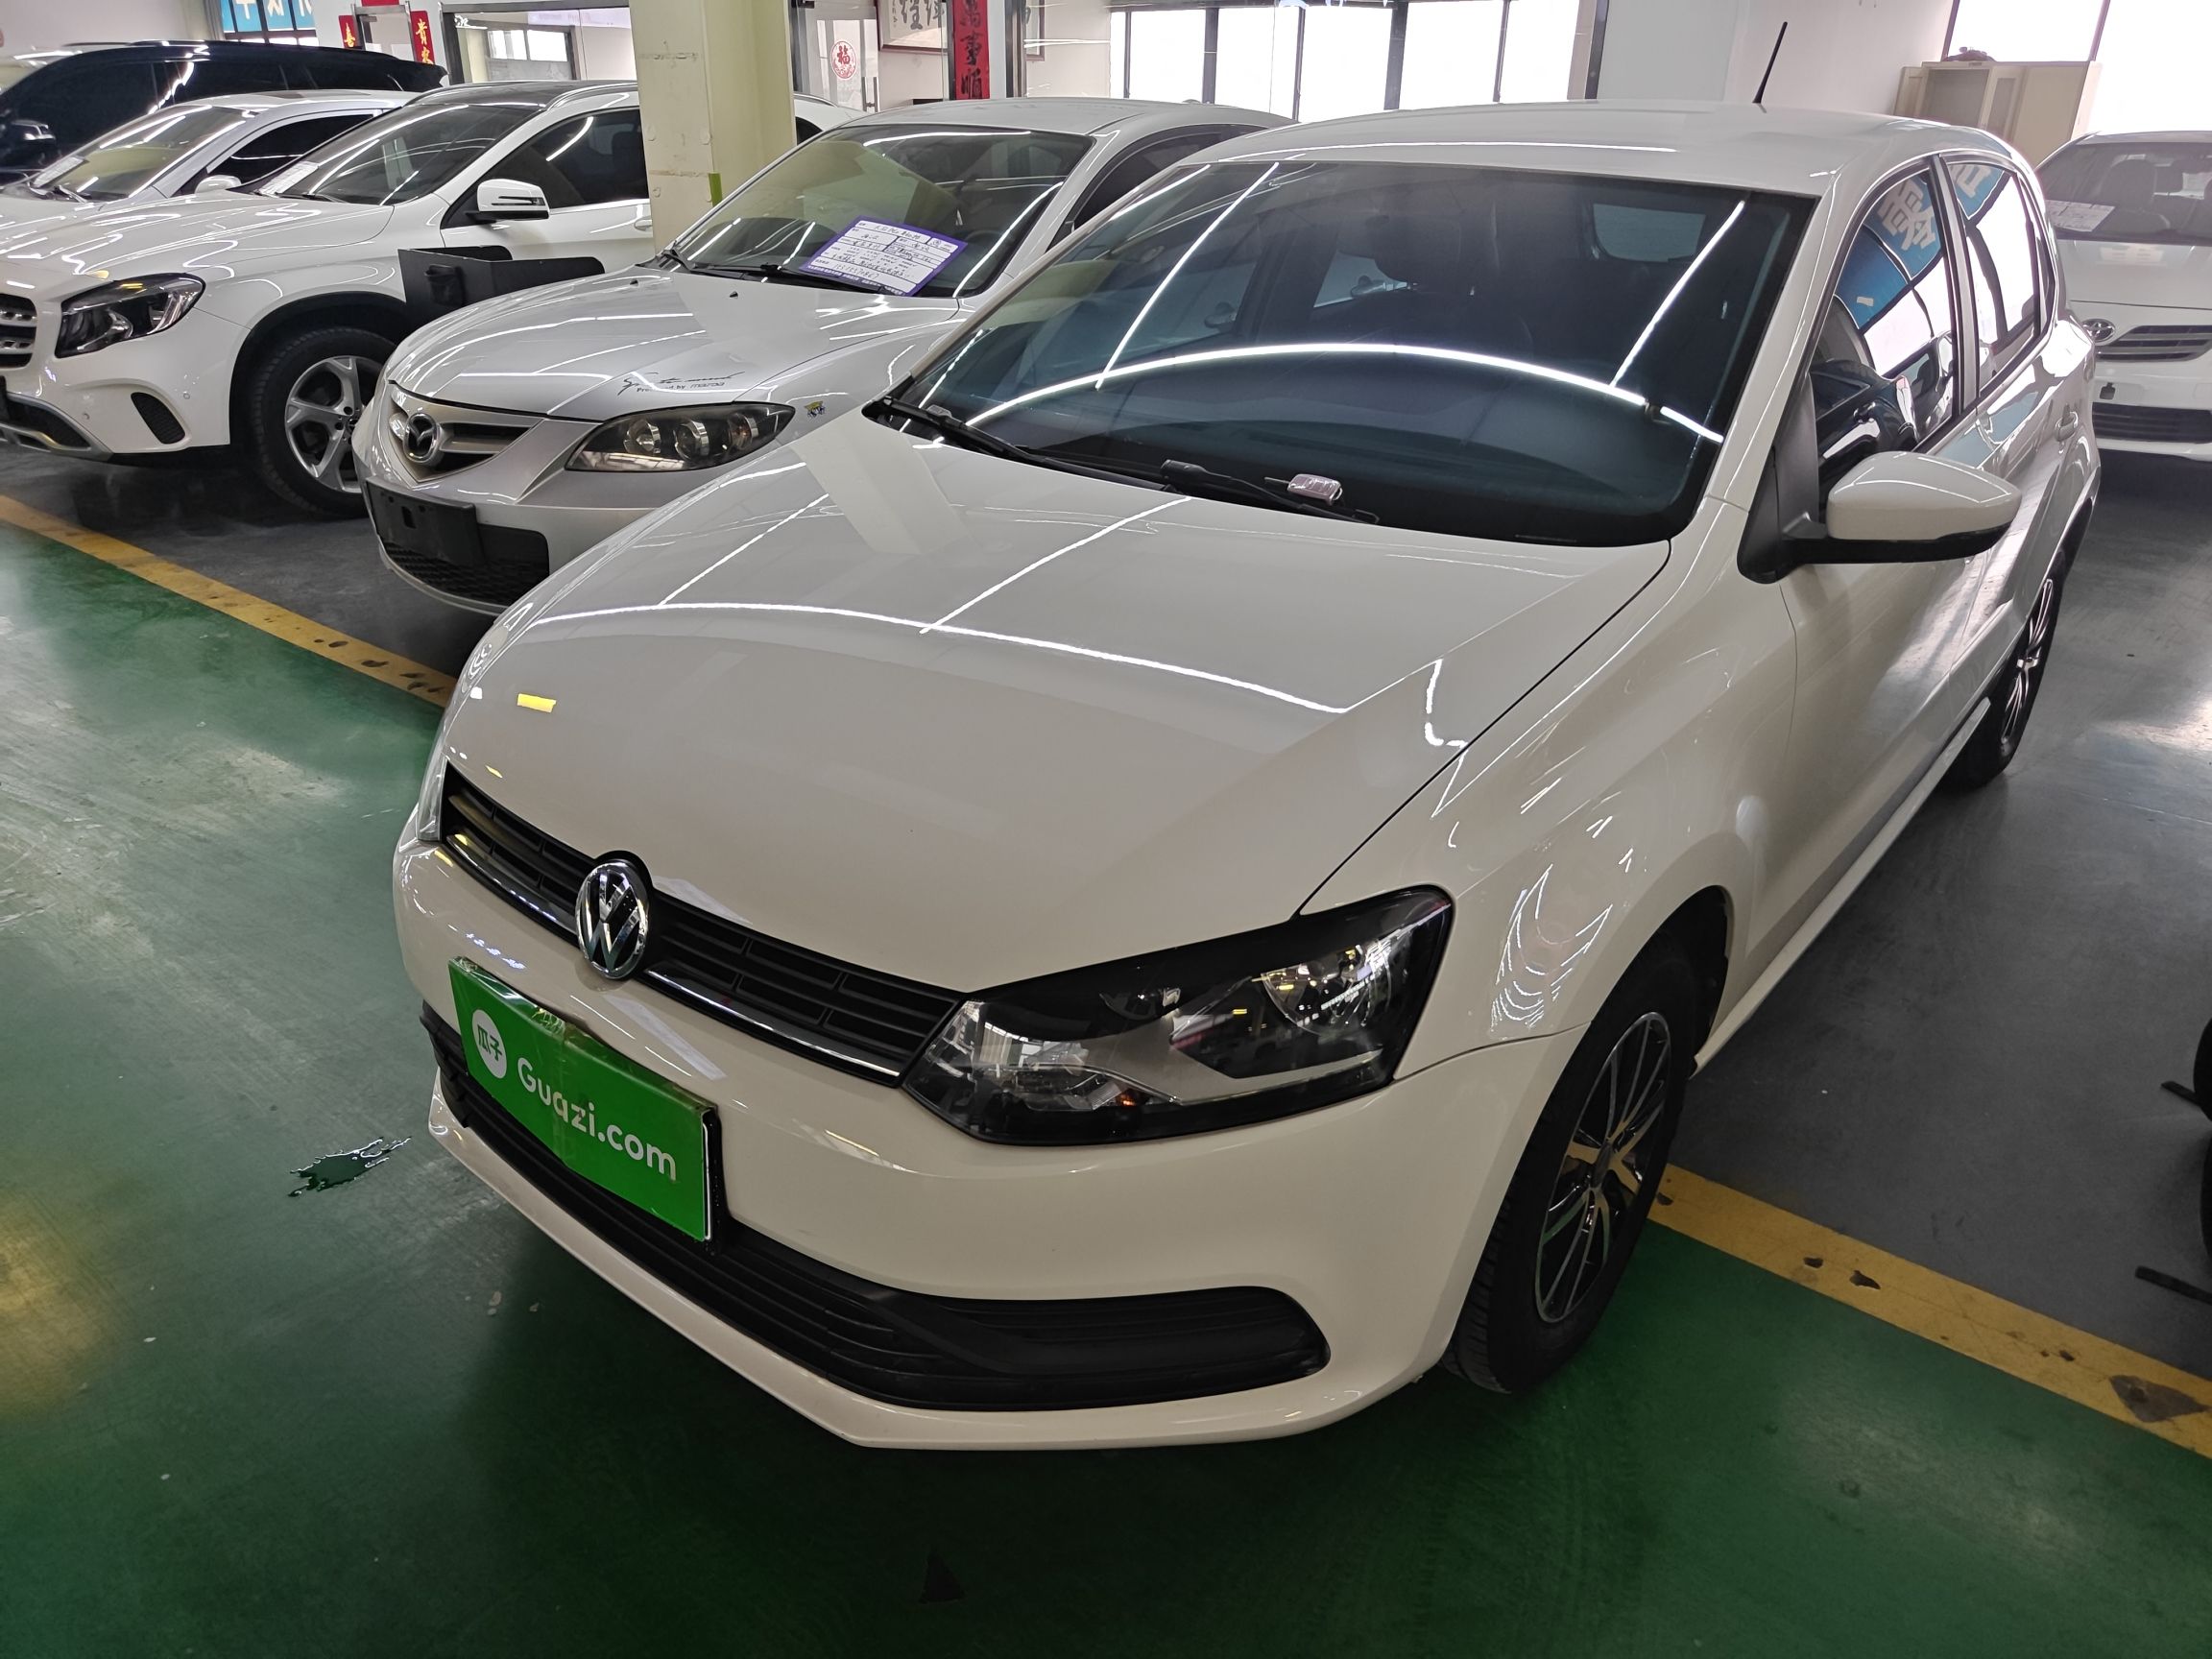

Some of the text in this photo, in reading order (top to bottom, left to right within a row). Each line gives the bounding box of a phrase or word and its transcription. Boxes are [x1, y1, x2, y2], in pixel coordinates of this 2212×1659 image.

[837, 44, 851, 64] 福
[477, 1023, 504, 1062] 瓜子
[517, 1056, 677, 1182] Guazi.com
